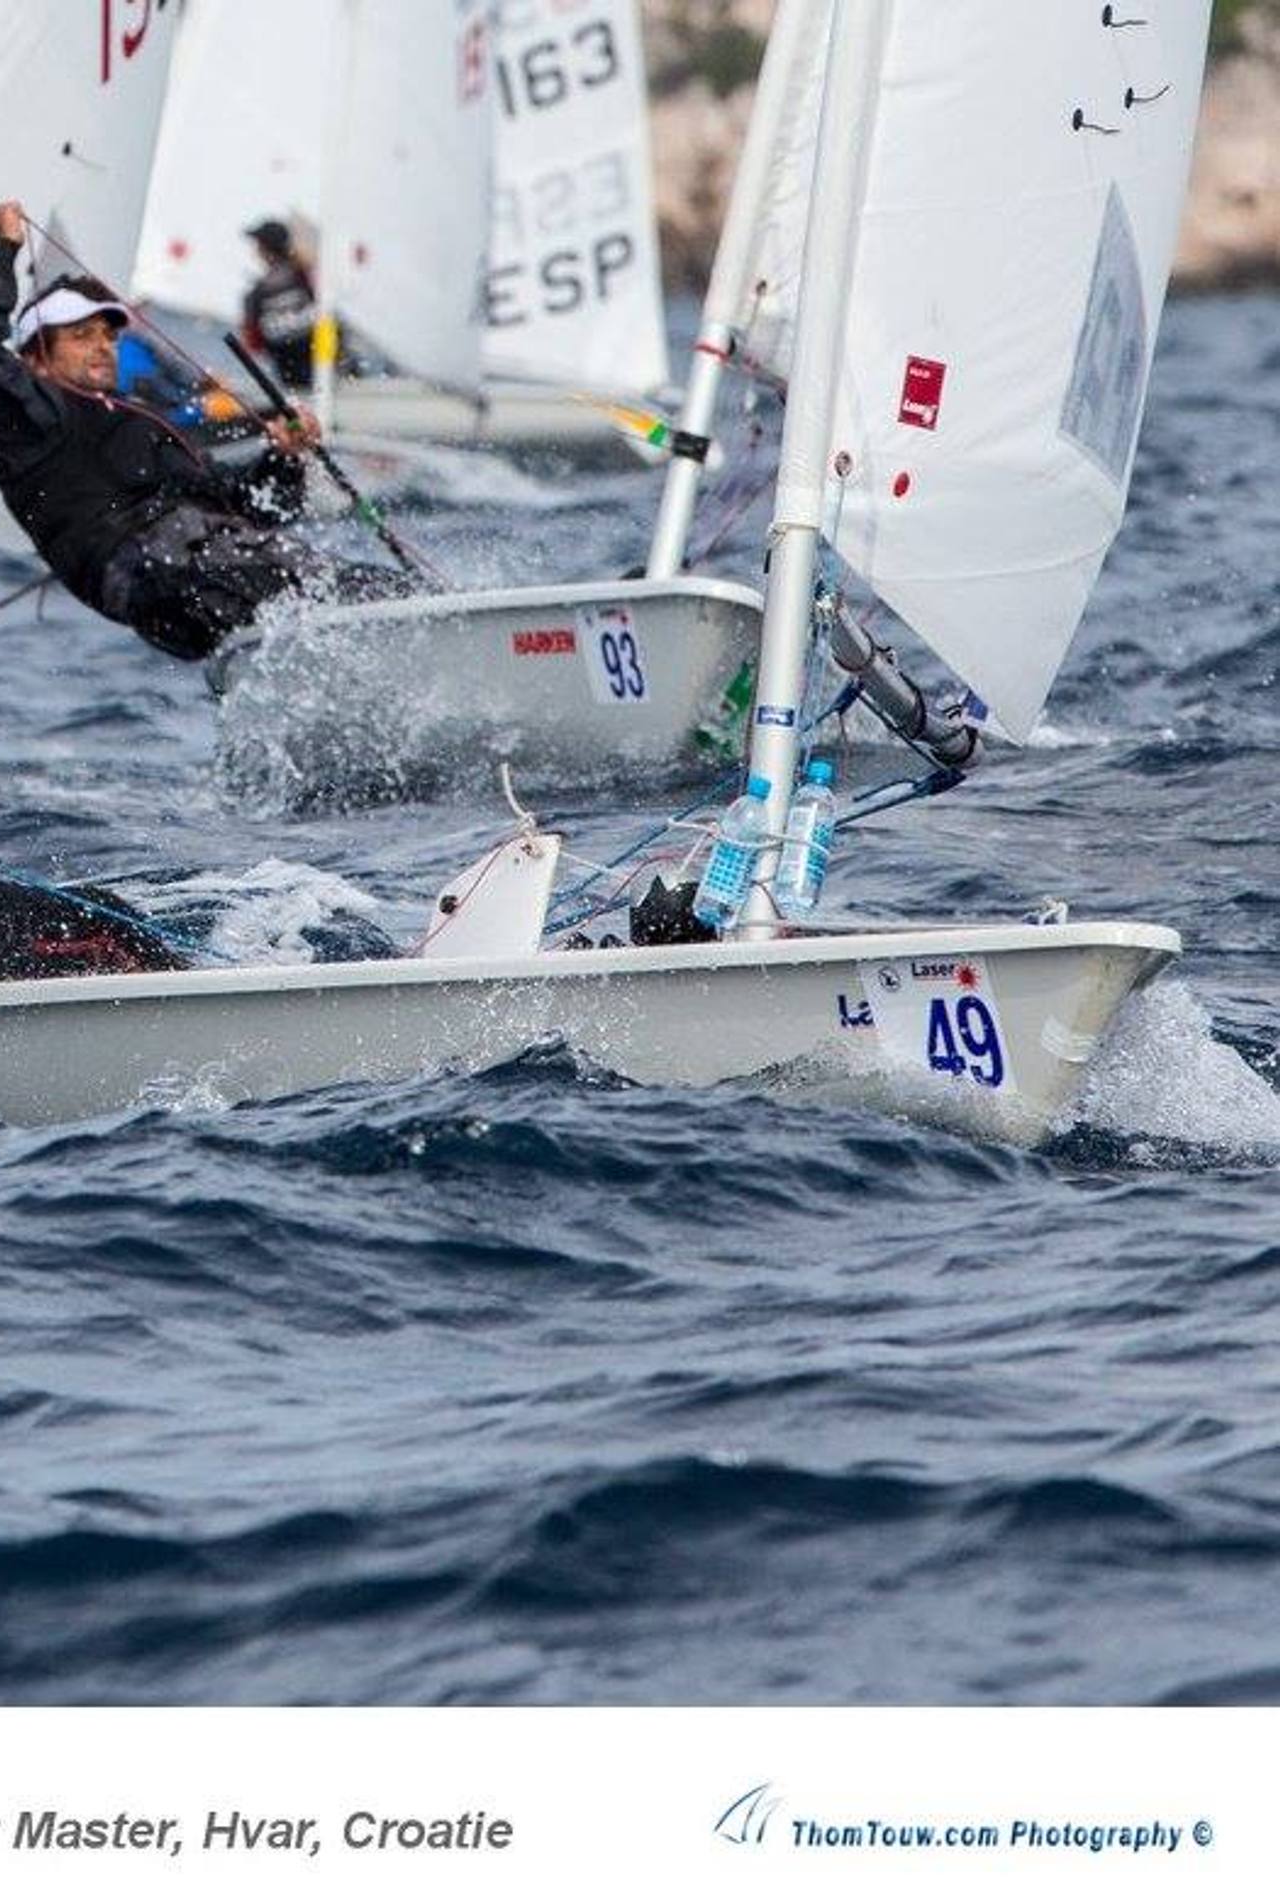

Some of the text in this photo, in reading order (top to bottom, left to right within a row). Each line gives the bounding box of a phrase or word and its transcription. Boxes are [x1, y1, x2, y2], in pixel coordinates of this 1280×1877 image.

[482, 232, 634, 328] ESP
[601, 632, 644, 698] 93
[911, 963, 955, 977] Laser
[928, 995, 1004, 1088] 49
